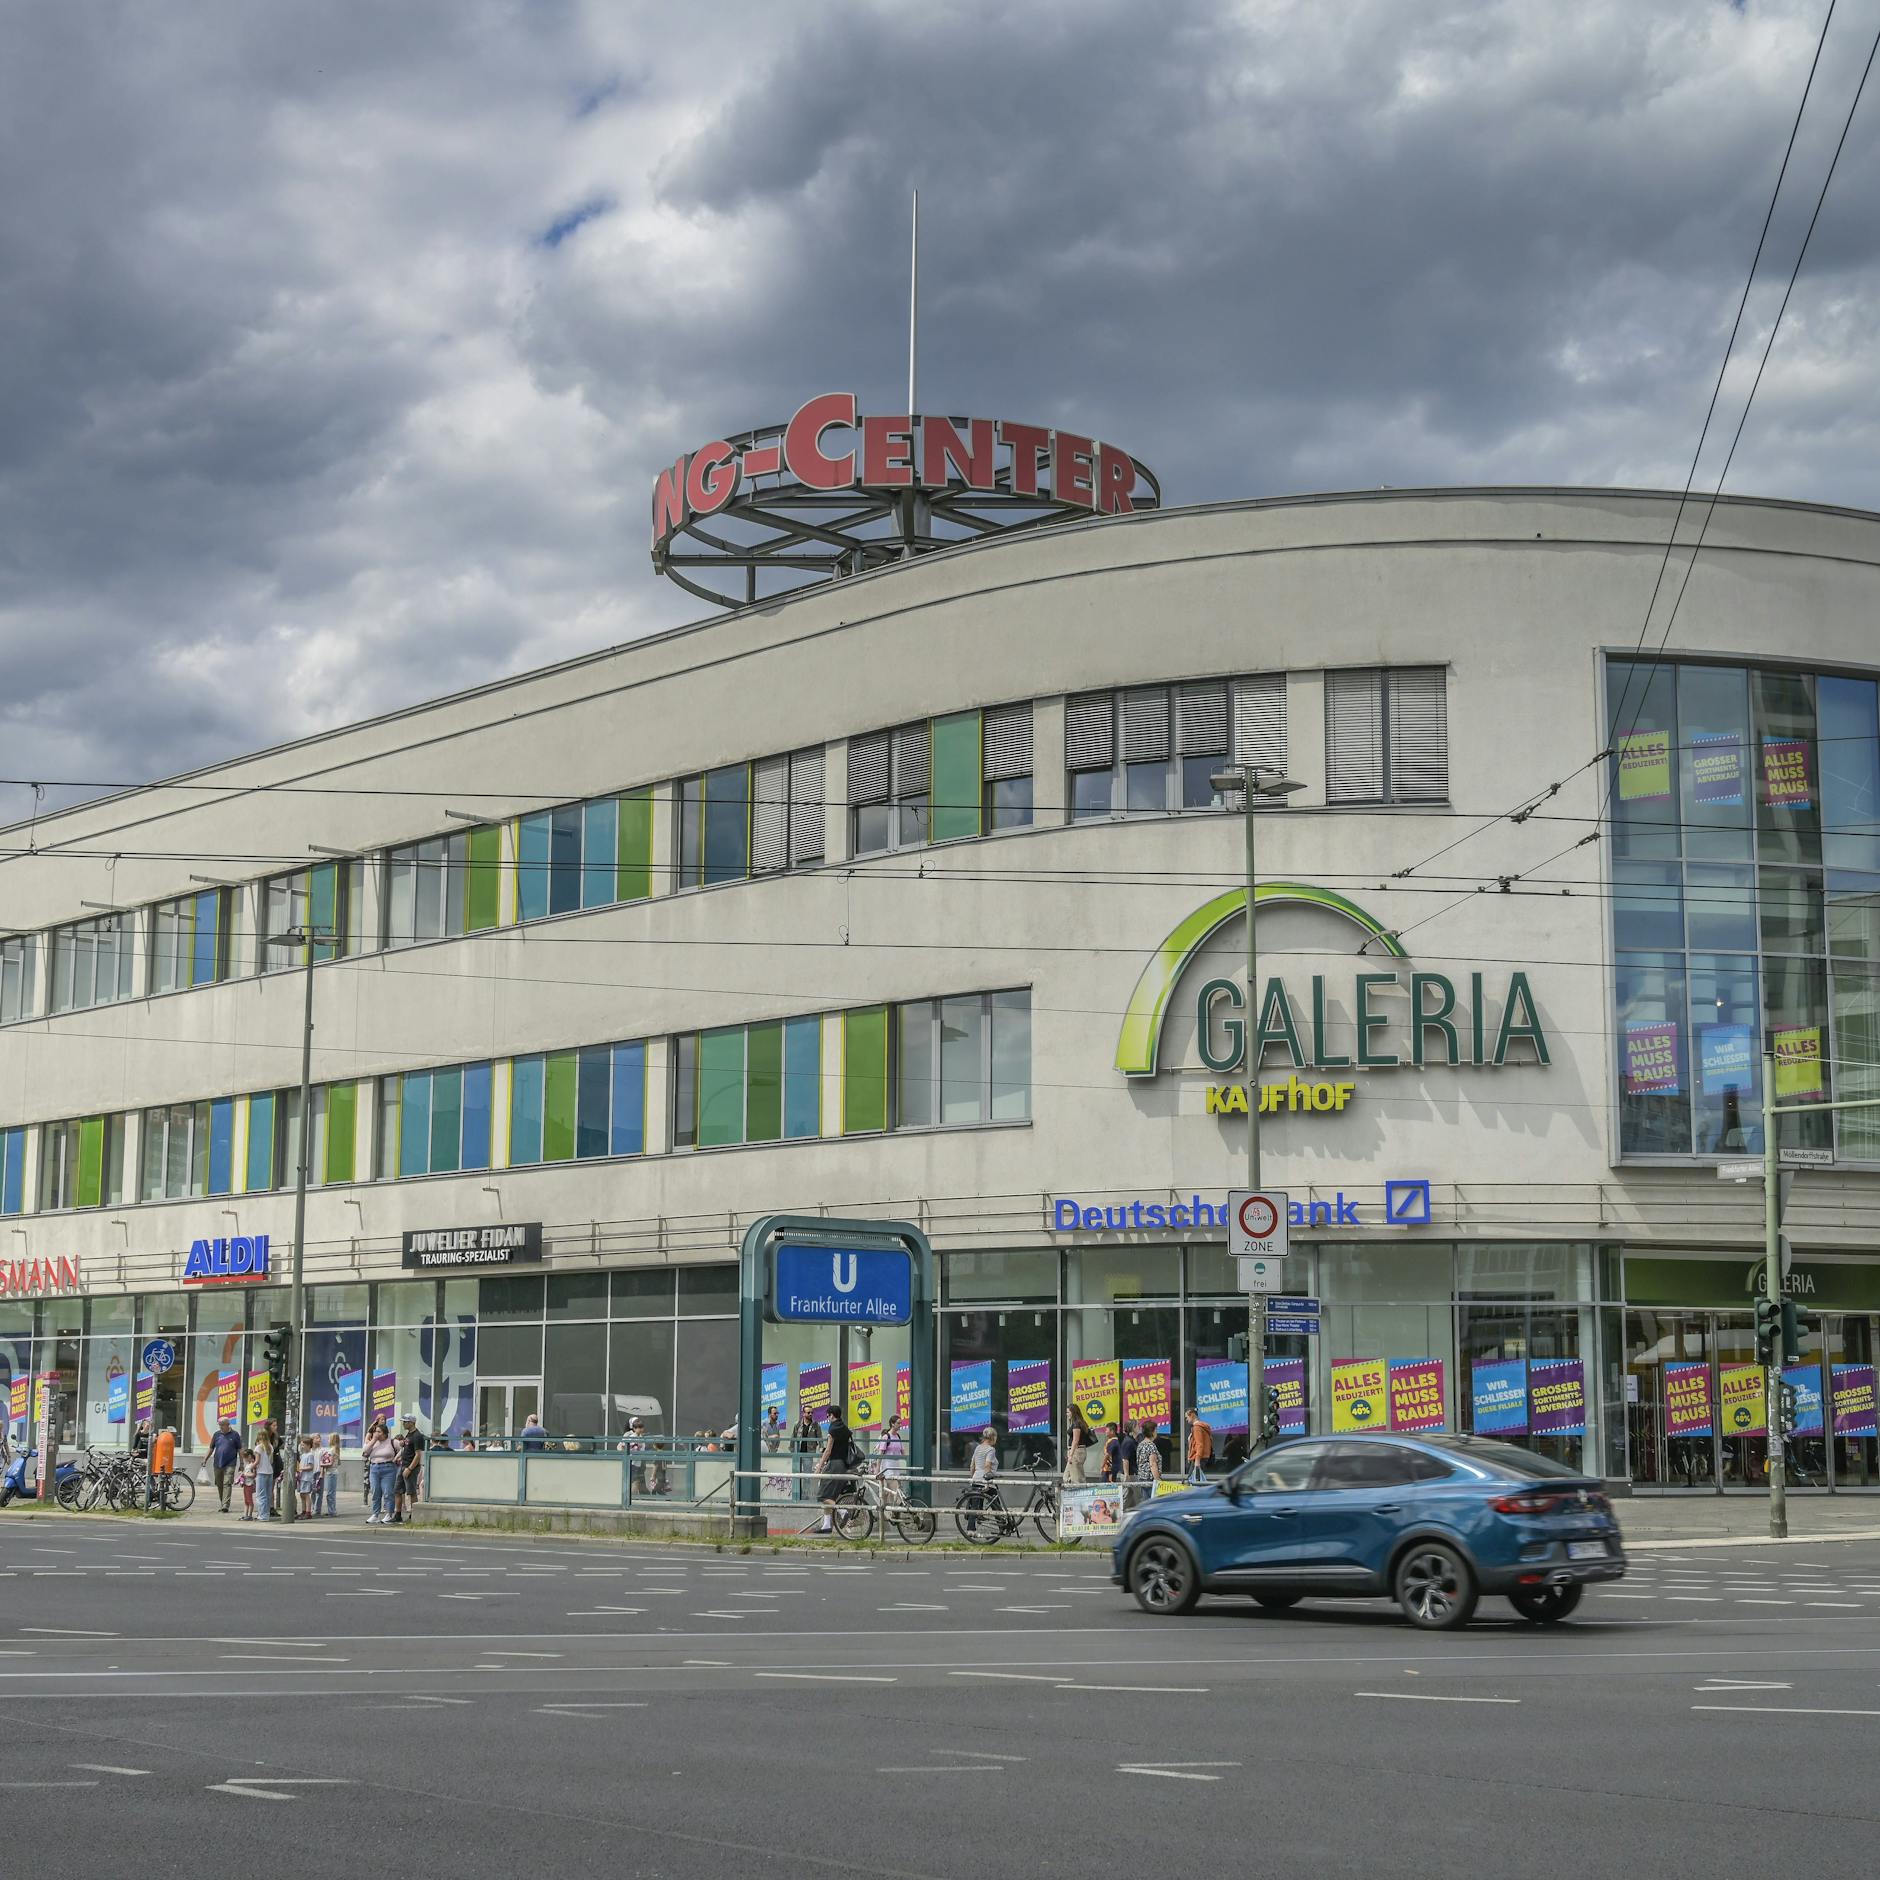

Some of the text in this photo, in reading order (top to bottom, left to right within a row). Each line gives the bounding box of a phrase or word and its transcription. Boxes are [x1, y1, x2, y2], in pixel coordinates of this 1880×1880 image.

[1621, 743, 1666, 760] ALLES
[1694, 754, 1737, 768] GROSSER
[1764, 752, 1804, 768] ALLES
[1768, 766, 1805, 782] MUSS
[1770, 780, 1808, 796] RAUS!
[1196, 971, 1552, 1073] GALERIA
[1628, 1035, 1672, 1054] ALLES
[1714, 1043, 1735, 1054] WIR
[1776, 1039, 1817, 1056] ALLES
[1631, 1050, 1673, 1068] MUSS
[1702, 1052, 1749, 1068] SCHLIESSEN
[1633, 1065, 1677, 1083] RAUS!
[1288, 1192, 1360, 1226] ank
[410, 1226, 526, 1252] JUWELIER FIDAN
[1244, 1241, 1274, 1252] ZONE
[184, 1235, 269, 1276] ALDI
[421, 1249, 511, 1265] TRAURING-SPEZIALIST
[832, 1253, 857, 1293] U
[1253, 1280, 1267, 1288] frei
[790, 1296, 897, 1316] Frankfurter Allee
[11, 1383, 26, 1396] ALLES
[219, 1381, 236, 1396] ALLES
[250, 1381, 267, 1395] ALLES
[764, 1382, 777, 1392] WIR
[800, 1382, 830, 1397] GROSSER
[850, 1374, 880, 1392] ALLES
[962, 1381, 978, 1392] WIR
[1009, 1381, 1047, 1397] GROSSER
[1074, 1373, 1115, 1392] ALLES
[1125, 1373, 1165, 1392] ALLES
[1210, 1380, 1230, 1391] WIR
[1334, 1372, 1381, 1392] ALLES
[1391, 1372, 1437, 1392] ALLES
[1487, 1380, 1508, 1392] WIR
[1532, 1381, 1581, 1397] GROSSER
[1667, 1376, 1705, 1395] ALLES
[1722, 1376, 1761, 1396] ALLES
[219, 1391, 236, 1406] MUSS
[851, 1389, 880, 1401] REDUZIERT!
[951, 1389, 990, 1405] SCHLIESSEN
[1010, 1392, 1048, 1404] SORTIMENTS-
[1076, 1388, 1118, 1402] REDUZIERT!
[1127, 1388, 1166, 1406] MUSS
[1198, 1389, 1247, 1405] SCHLIESSEN
[1336, 1388, 1383, 1402] REDUZIERT!
[1395, 1388, 1439, 1407] MUSS
[1474, 1389, 1525, 1406] SCHLIESSEN
[1534, 1391, 1582, 1405] SORTIMENTS-
[1670, 1391, 1707, 1409] MUSS
[1724, 1391, 1763, 1404] REDUZIERT!
[1833, 1386, 1873, 1400] GROSSER
[1011, 1398, 1049, 1413] ABVERKAUF
[1478, 1401, 1523, 1414] DIESE FILIALE
[1536, 1399, 1583, 1414] ABVERKAUF
[1835, 1395, 1873, 1408] SORTIMENTS-
[1836, 1402, 1875, 1416] ABVERKAUF
[1087, 1407, 1103, 1415] 40%
[1129, 1402, 1170, 1420] RAUS!
[1352, 1407, 1370, 1416] 40%
[1396, 1402, 1443, 1422] RAUS!
[1671, 1405, 1710, 1424] RAUS!
[1735, 1414, 1750, 1423] 40%
